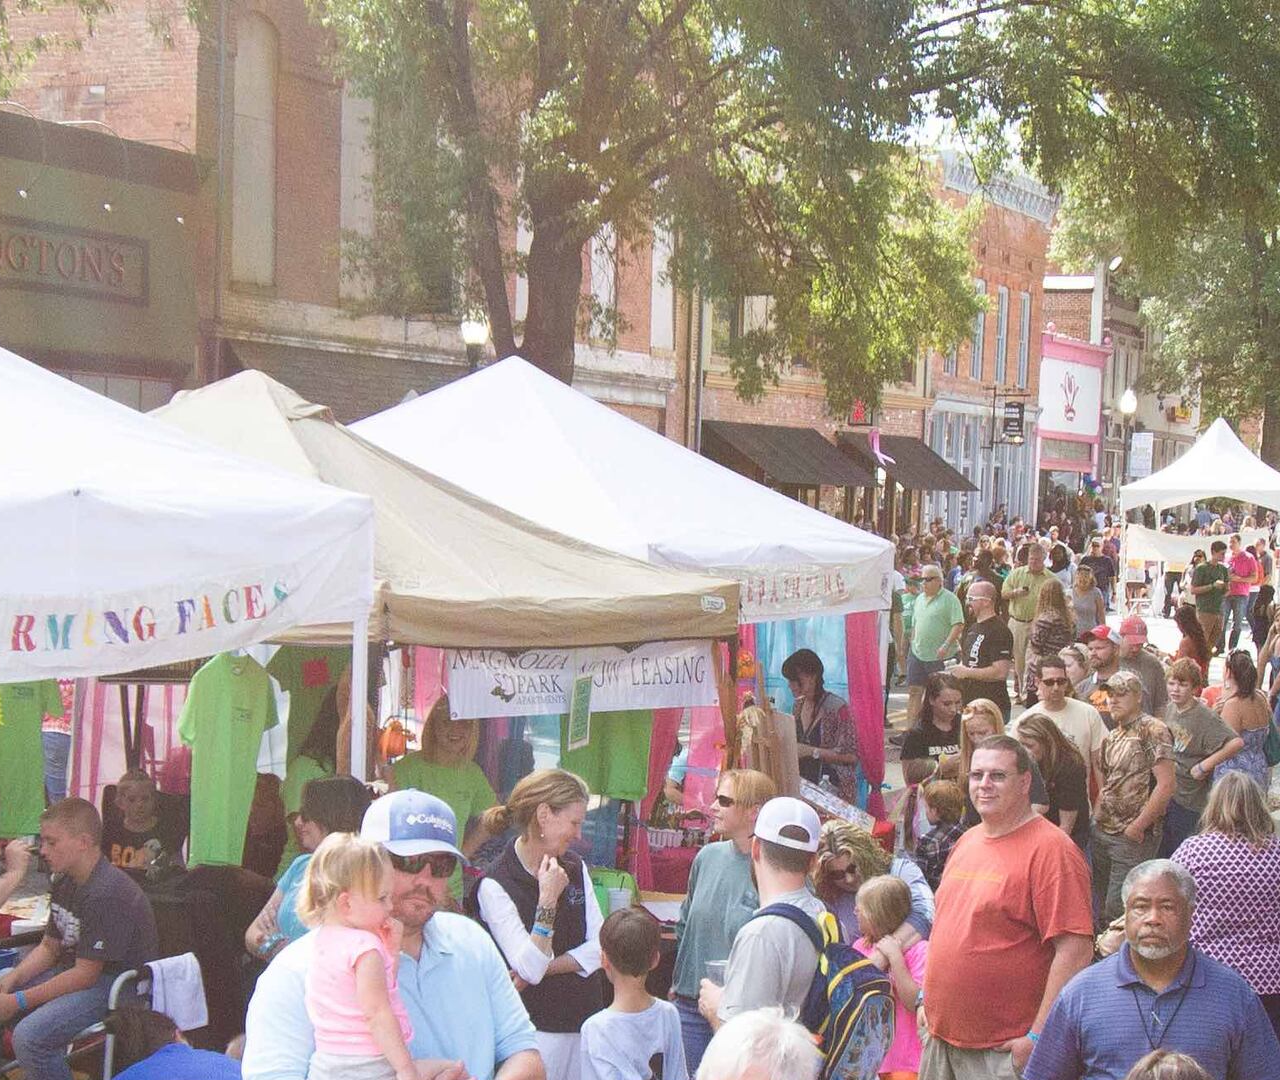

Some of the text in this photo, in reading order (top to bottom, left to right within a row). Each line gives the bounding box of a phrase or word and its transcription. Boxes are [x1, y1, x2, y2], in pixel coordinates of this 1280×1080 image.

[174, 579, 290, 636] FACES
[517, 674, 565, 694] PARK
[630, 655, 706, 687] LEASING
